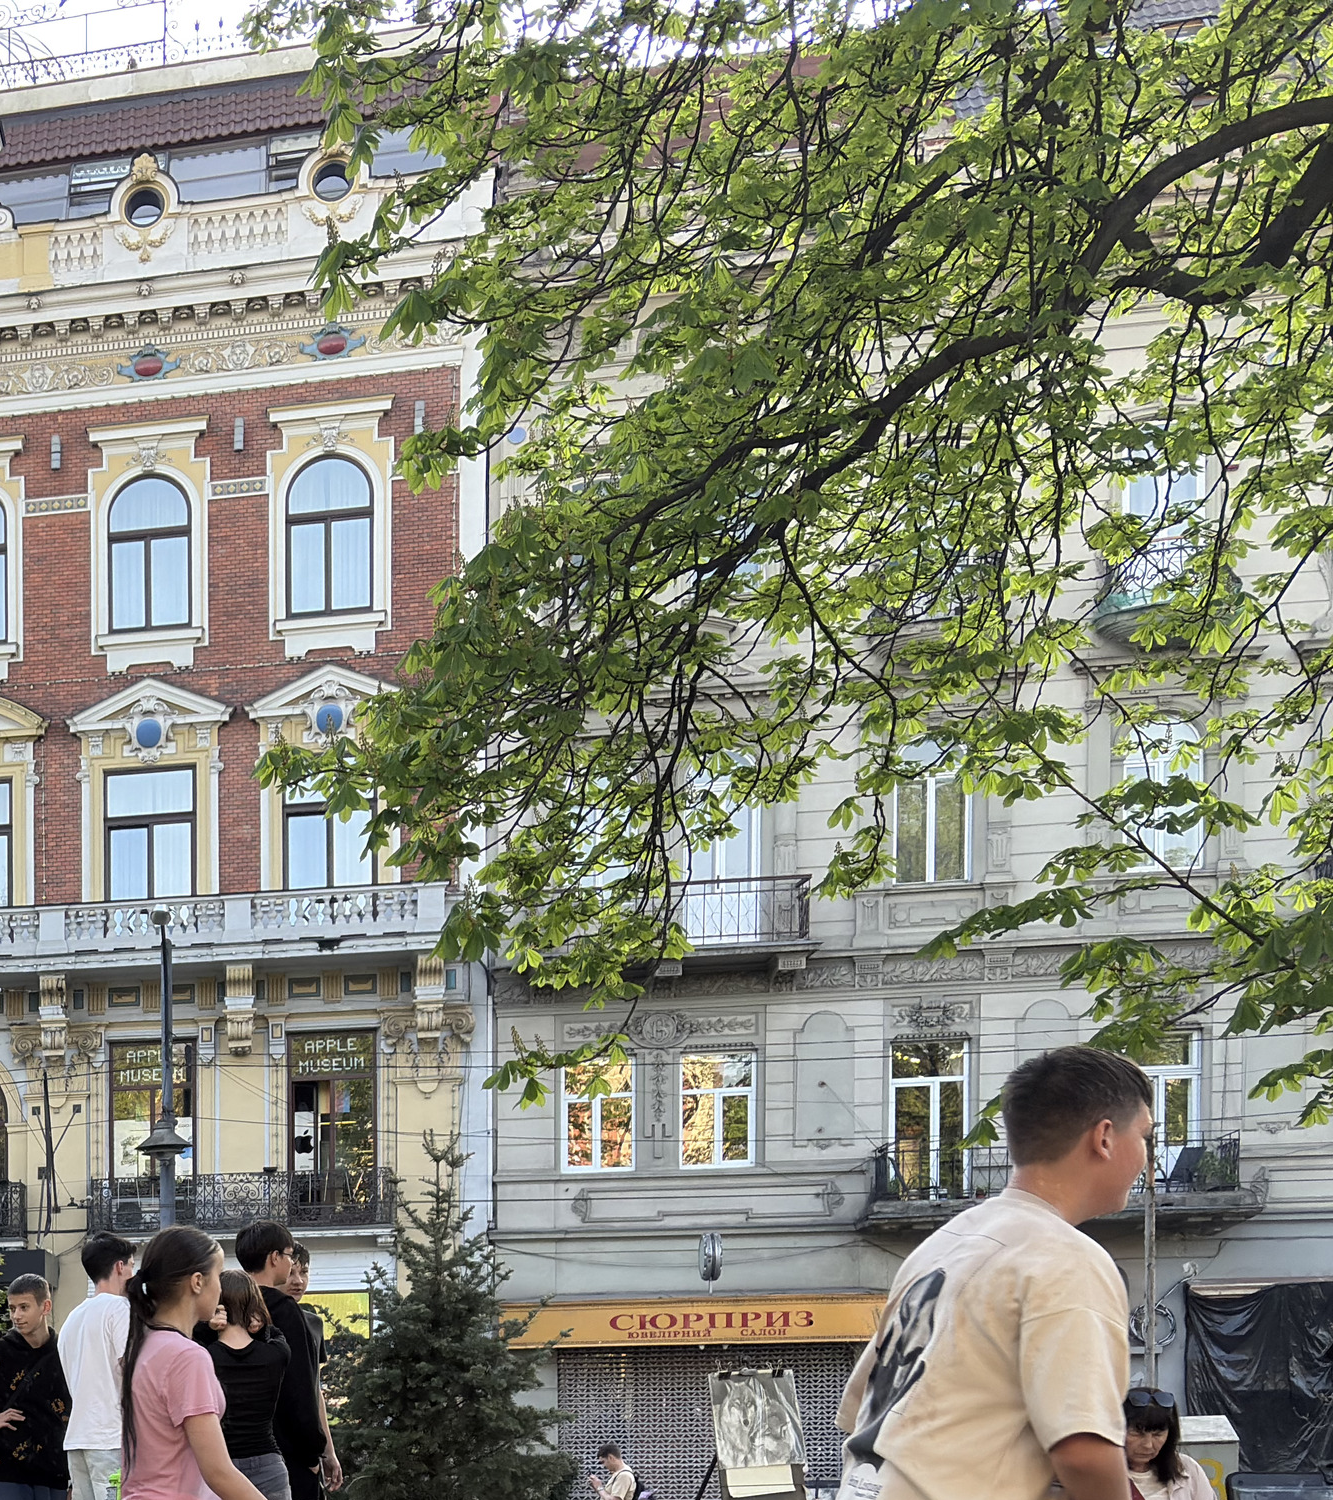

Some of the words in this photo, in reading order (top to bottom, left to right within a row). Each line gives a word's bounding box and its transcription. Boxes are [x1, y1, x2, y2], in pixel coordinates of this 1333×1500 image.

[304, 1037, 357, 1054] APPLE
[298, 1056, 365, 1074] MUSEUM
[120, 1067, 185, 1084] MUSEM
[609, 1310, 814, 1331] СЮРПРИЗ
[627, 1327, 712, 1339] ЮВЕЛІРНИЙ
[740, 1328, 787, 1337] САЛОН
